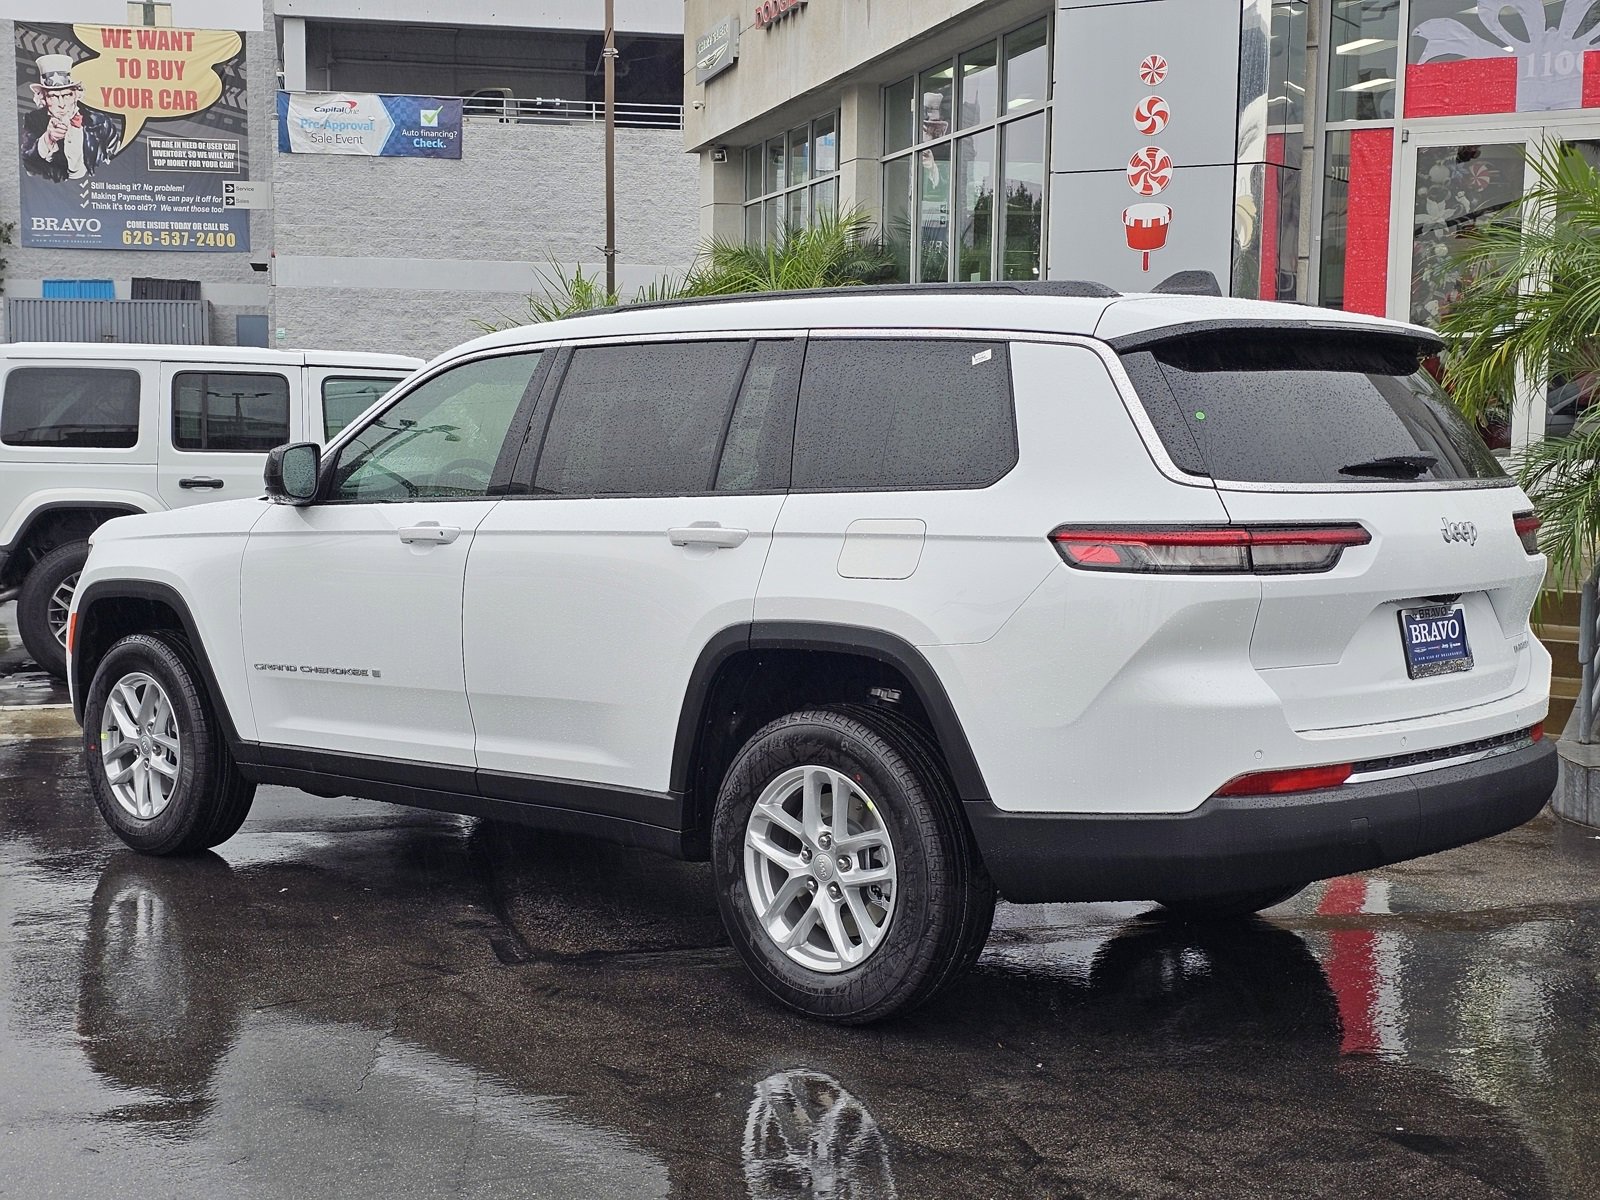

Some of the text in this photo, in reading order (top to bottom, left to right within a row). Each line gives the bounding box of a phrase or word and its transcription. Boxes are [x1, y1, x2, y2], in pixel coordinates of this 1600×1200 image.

[101, 28, 195, 51] WE WANT
[116, 58, 185, 80] TO BUY
[101, 87, 198, 110] YOUR CAR
[300, 118, 374, 132] Pre-Approval
[311, 132, 364, 144] Sale Event
[420, 130, 458, 140] financing?
[150, 140, 237, 151] WE ARE IN NEED OF USED CAR
[413, 138, 447, 148] Check.
[152, 150, 235, 160] INVENTORY, SO WE WILL PAY
[153, 159, 234, 169] TOP MONEY FOR YOUR CAR!
[90, 181, 185, 193] Still leasing it? No problem!
[91, 191, 116, 202] Making
[117, 192, 154, 203] Payments,
[155, 193, 166, 202] We
[181, 195, 194, 205] pay
[195, 194, 201, 203] it
[201, 195, 212, 203] off
[212, 195, 223, 203] for
[91, 201, 112, 210] Think
[112, 202, 124, 211] it's
[124, 203, 136, 211] too
[137, 203, 157, 212] old??
[160, 204, 172, 212] We
[190, 205, 210, 214] those
[31, 217, 102, 232] BRAVO
[126, 220, 229, 231] COME INSIDE TODAY OR CALL US
[122, 230, 237, 248] 626-537-2400
[1441, 517, 1477, 546] Jeep
[1418, 606, 1447, 618] BRAVO
[1409, 619, 1460, 644] BRAVO
[253, 663, 298, 672] GRAND
[299, 665, 369, 677] CHEROKEE
